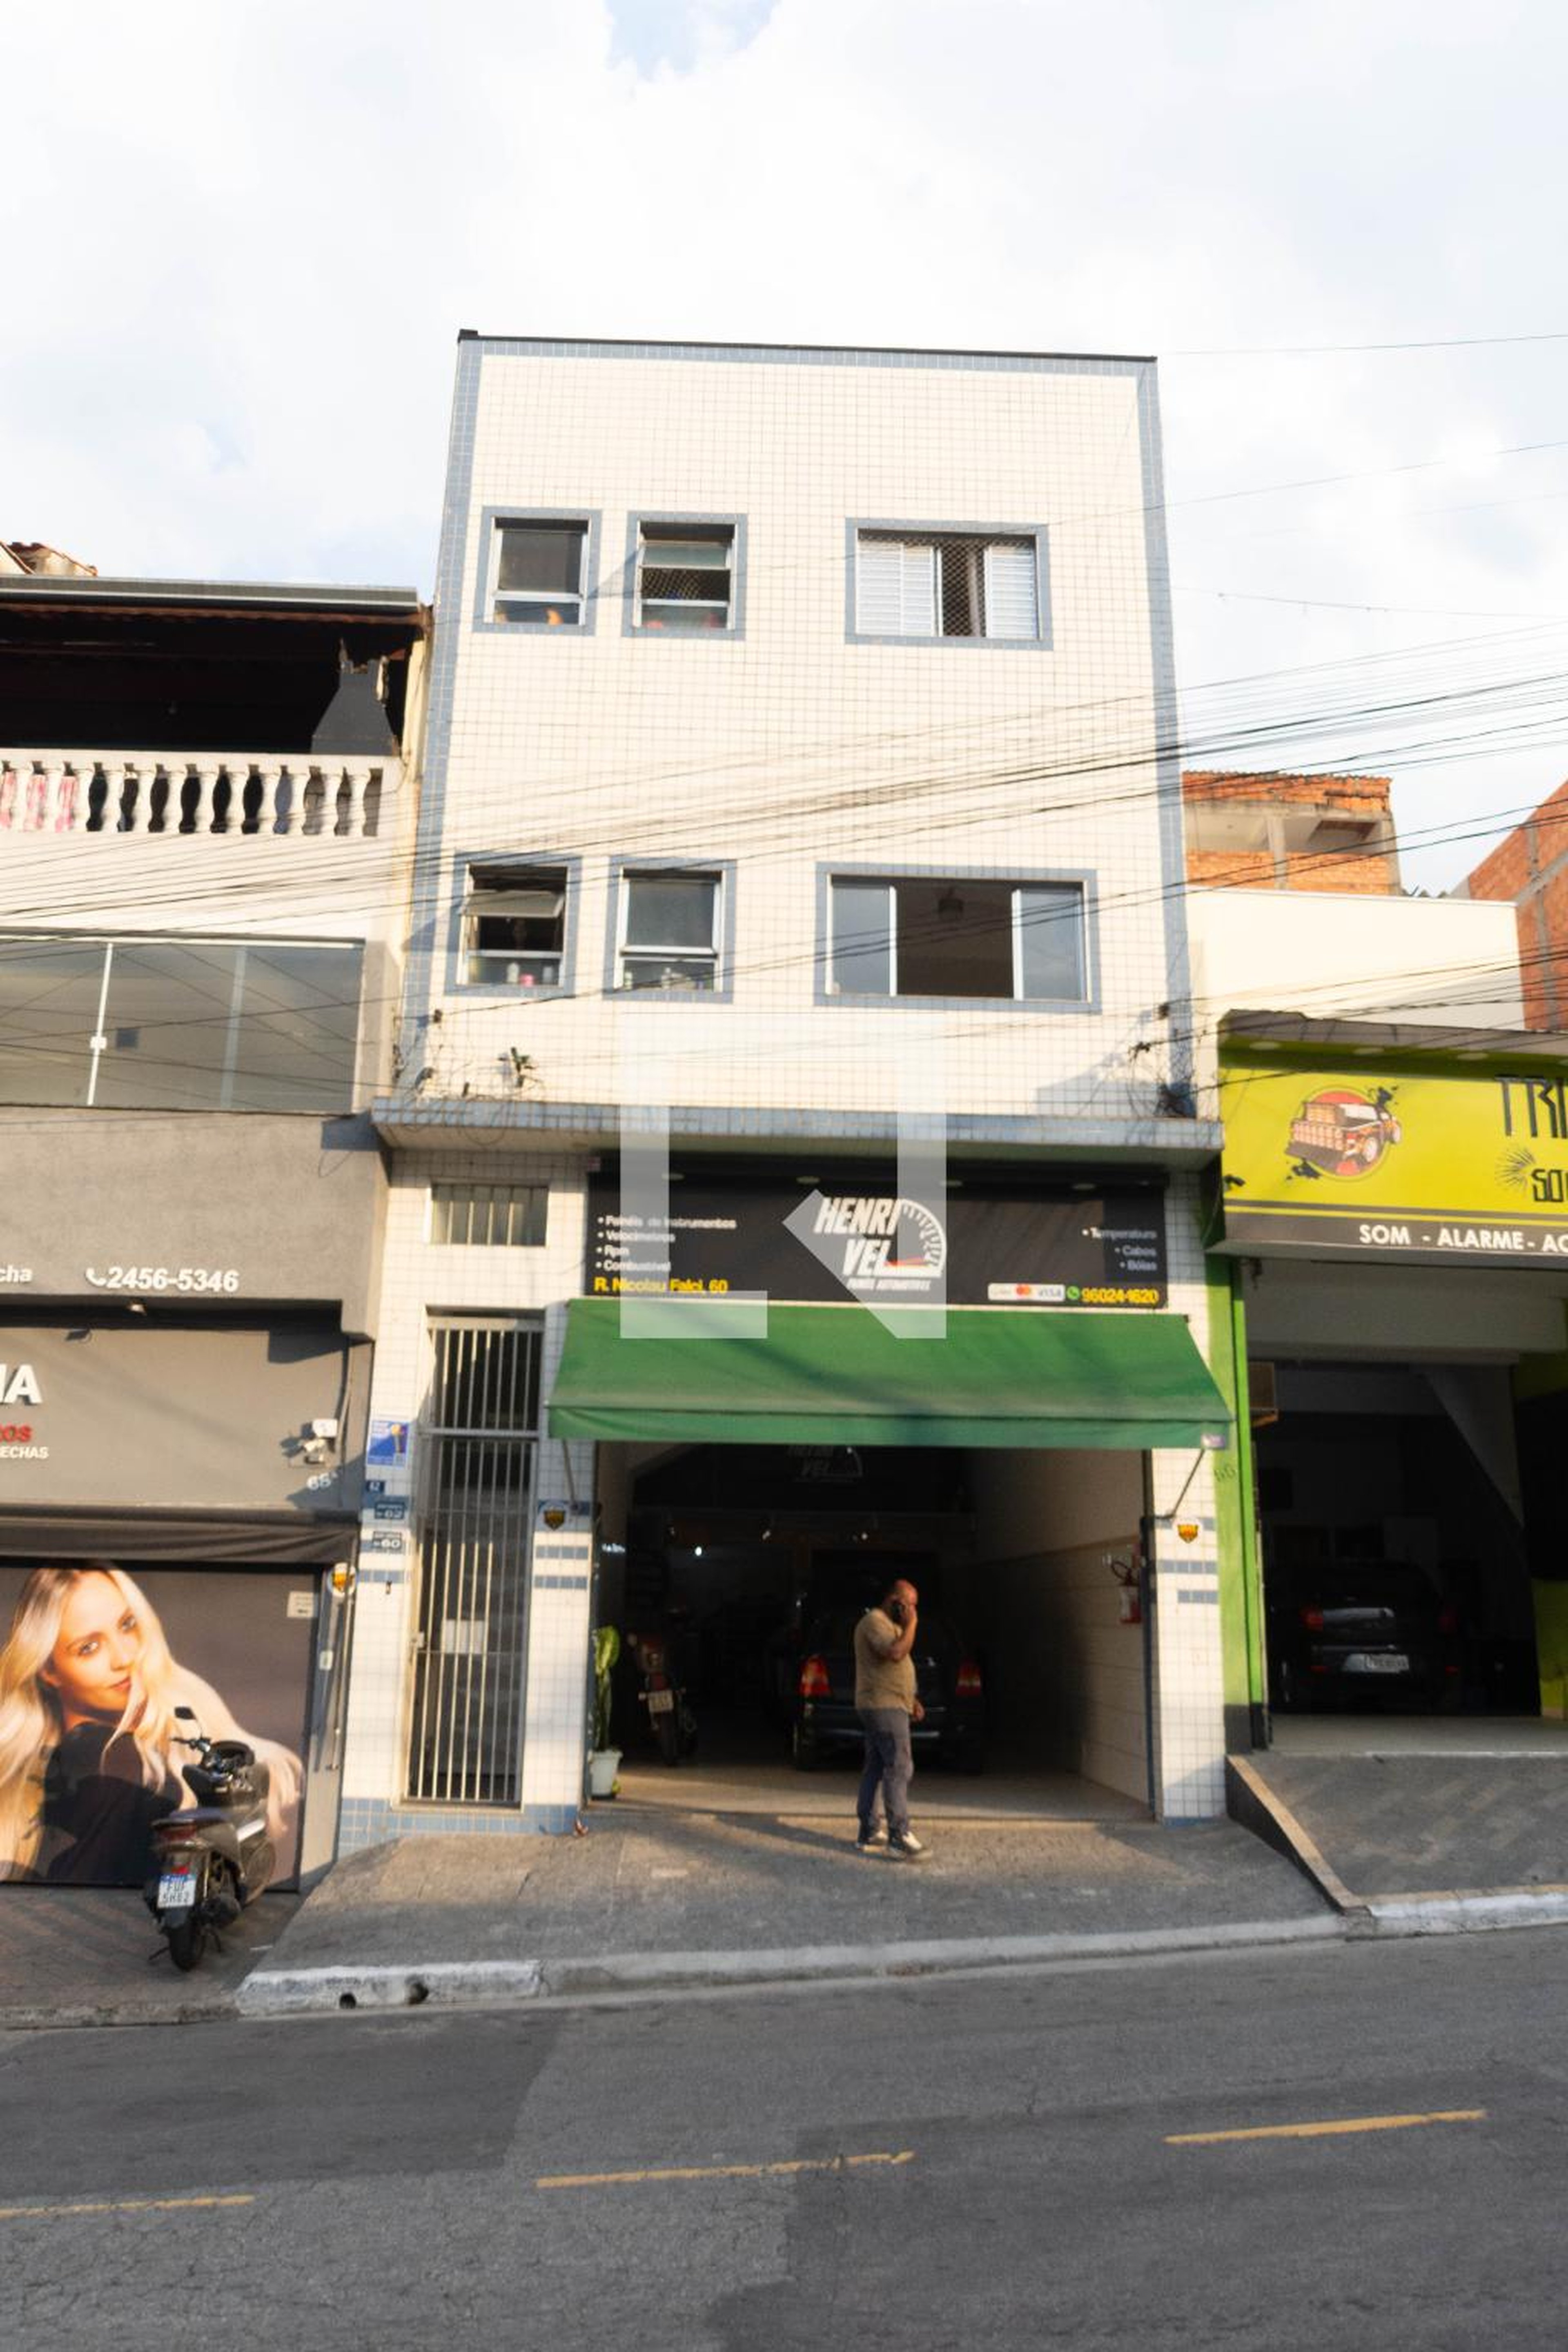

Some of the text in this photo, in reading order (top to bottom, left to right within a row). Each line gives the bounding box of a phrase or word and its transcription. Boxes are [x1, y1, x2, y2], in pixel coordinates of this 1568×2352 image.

[1531, 1168, 1568, 1203] SO
[814, 1197, 901, 1234] HENRI
[1359, 1225, 1410, 1245] SOM
[1437, 1227, 1524, 1250] ALARME
[843, 1239, 902, 1275] VEL
[106, 1267, 239, 1292] 2456-5346
[709, 1279, 728, 1294] 60
